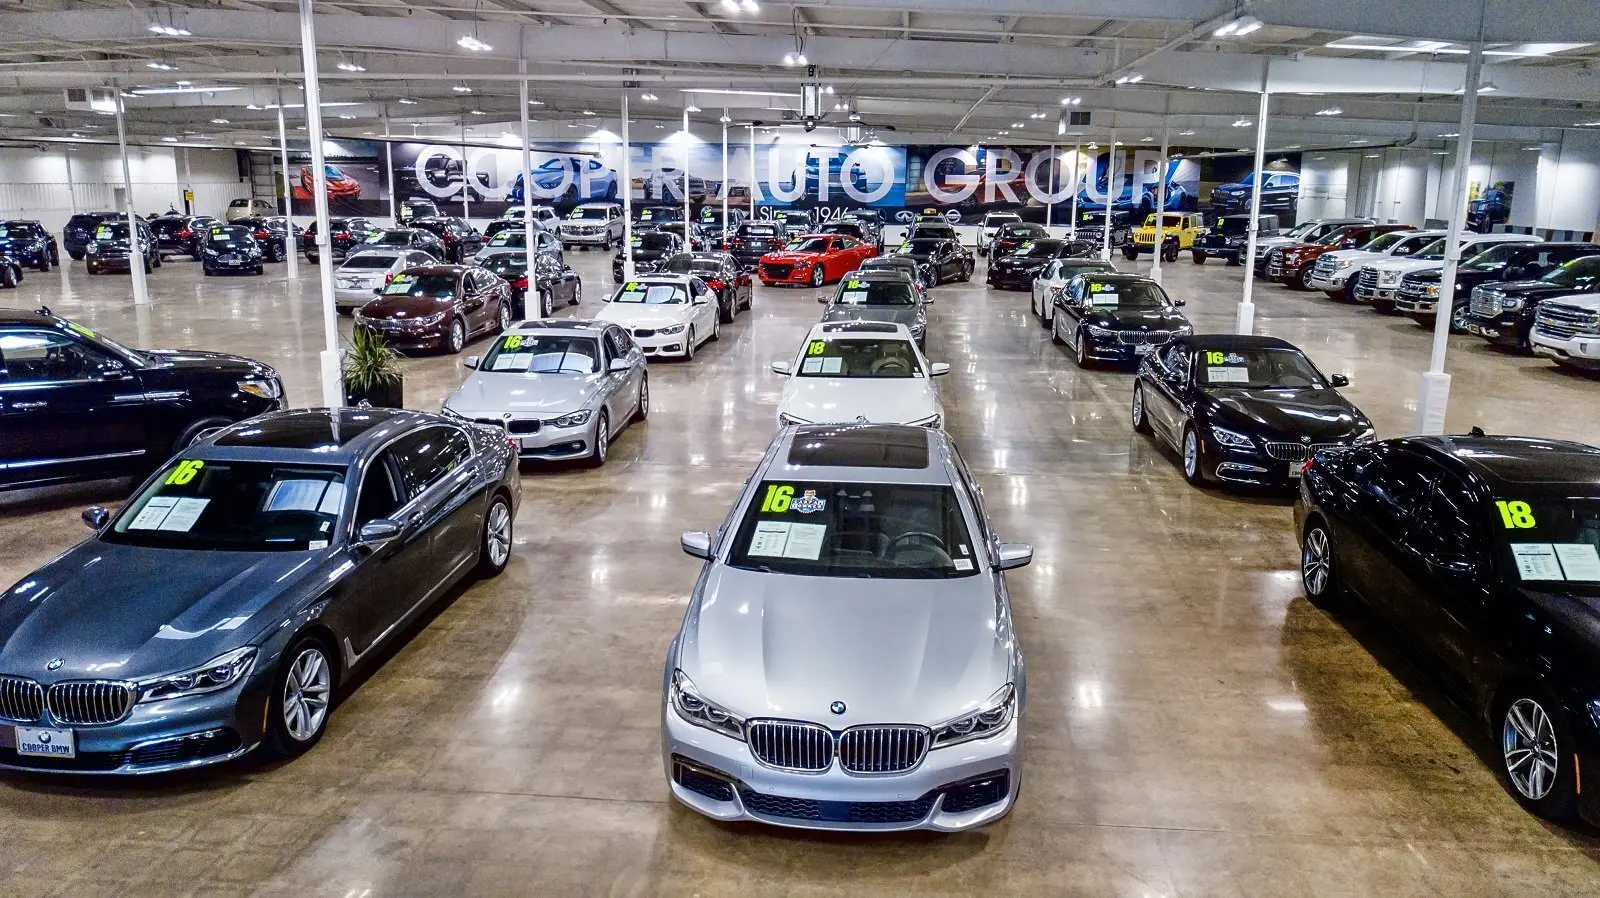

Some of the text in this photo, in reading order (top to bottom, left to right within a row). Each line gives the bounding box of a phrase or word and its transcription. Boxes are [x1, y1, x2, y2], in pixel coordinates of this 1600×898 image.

[416, 145, 1164, 204] COOPER AUTO GROUP
[504, 336, 522, 349] 16
[808, 341, 825, 355] 18
[1206, 352, 1224, 365] 16
[165, 460, 204, 485] 16
[762, 485, 795, 512] 16
[1495, 500, 1536, 529] 18
[22, 742, 70, 753] COOPER BMW
